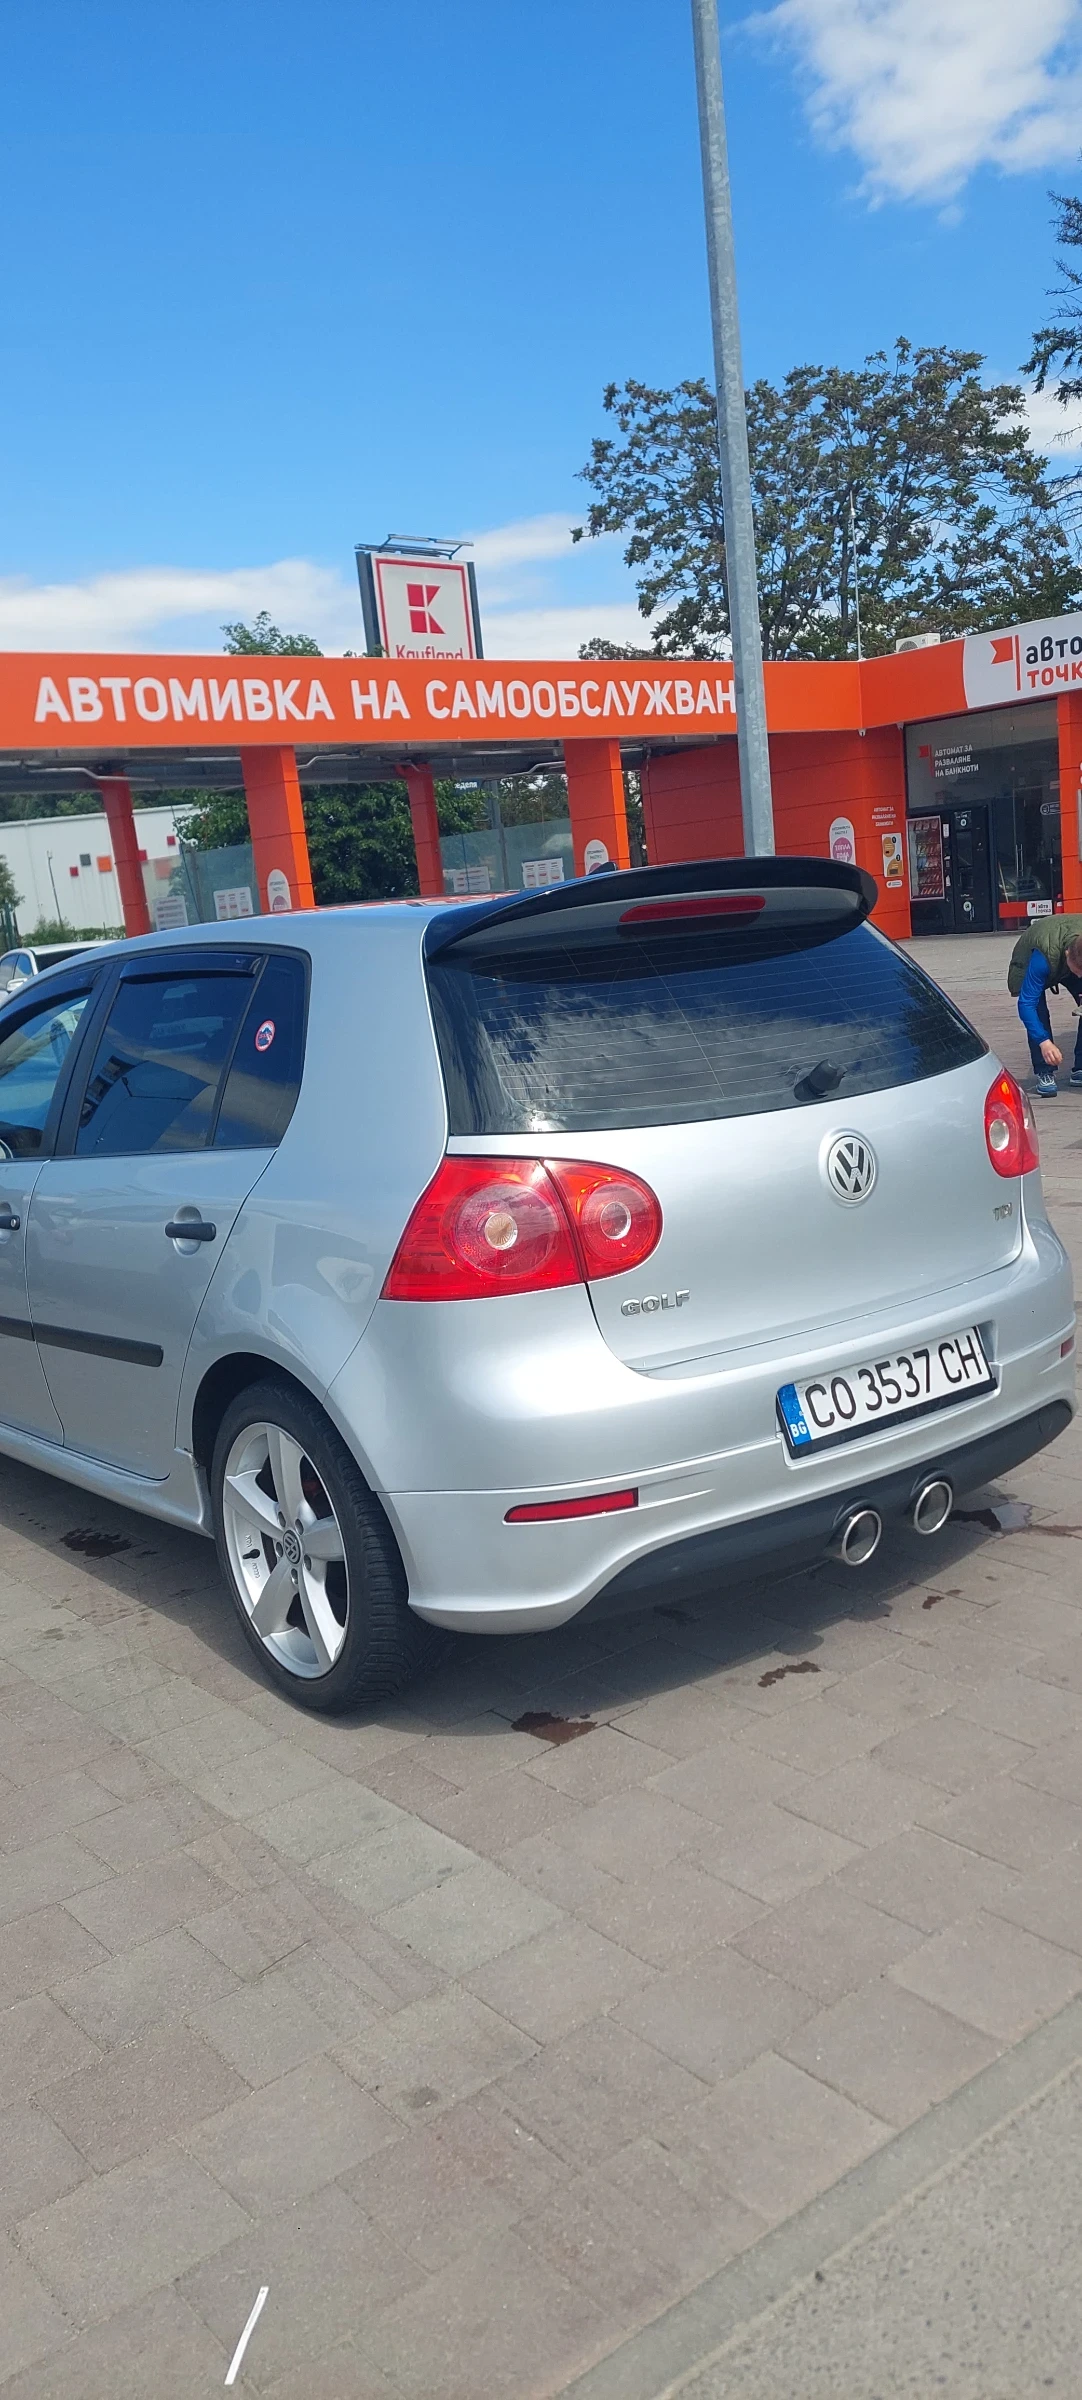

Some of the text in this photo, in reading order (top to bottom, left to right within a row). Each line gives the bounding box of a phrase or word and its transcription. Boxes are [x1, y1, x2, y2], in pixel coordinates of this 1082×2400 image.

[1026, 635, 1082, 665] авто
[34, 676, 336, 723] АВТОМИВКА
[350, 679, 411, 720] НА
[934, 743, 973, 758] АВТОМАТ ЗА
[934, 754, 972, 768] РАЗВАЛЯНЕ
[935, 763, 979, 778] НА БАНКНОТИ
[454, 781, 478, 790] еделя
[620, 1289, 690, 1317] GOLF
[857, 1348, 931, 1411] 3537
[790, 1422, 808, 1438] BG
